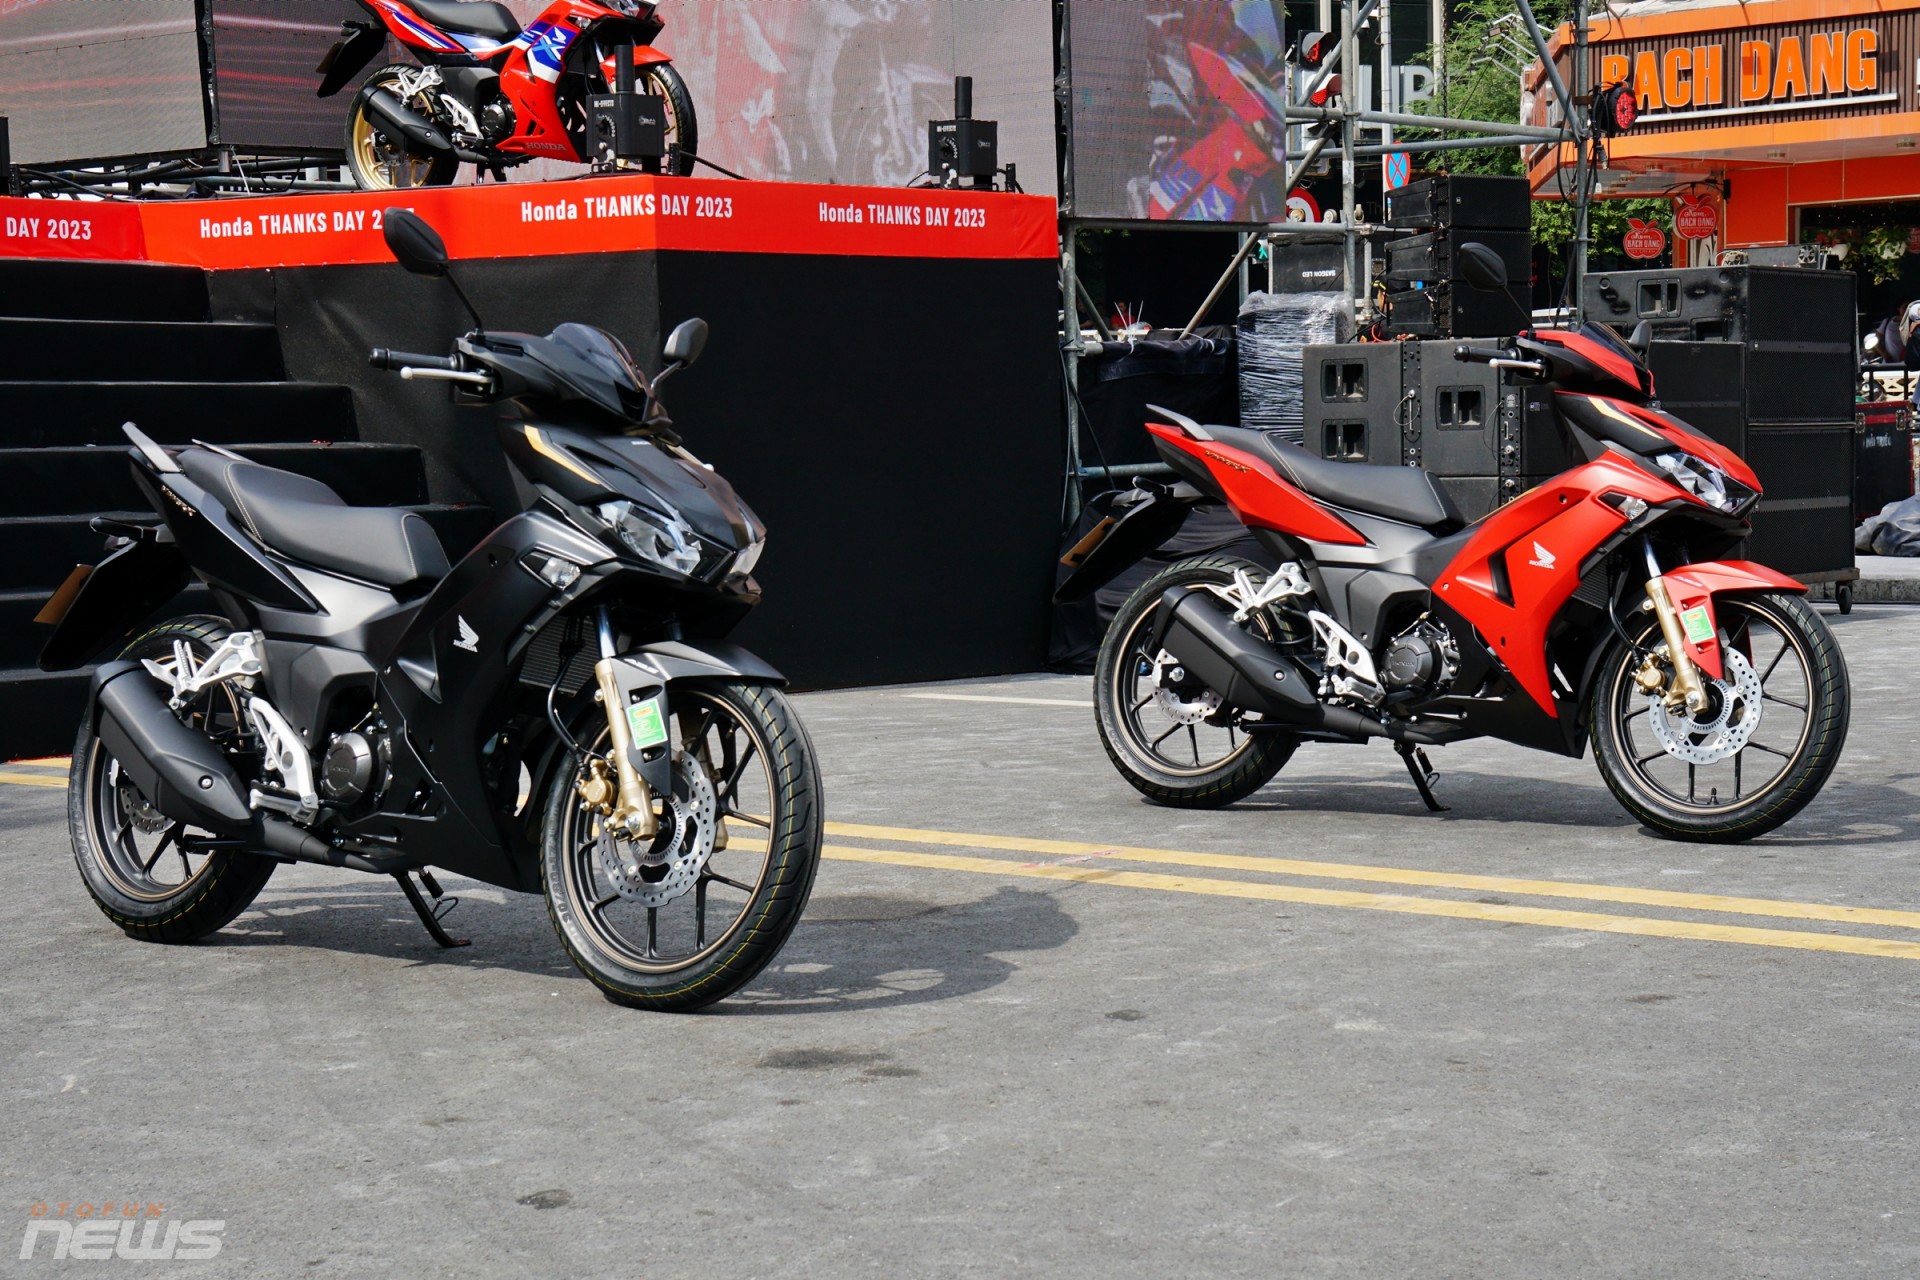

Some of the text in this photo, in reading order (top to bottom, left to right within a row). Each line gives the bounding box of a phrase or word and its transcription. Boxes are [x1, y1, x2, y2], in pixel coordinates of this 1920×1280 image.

[1739, 28, 1878, 101] DANG
[525, 141, 567, 151] HONDA
[521, 194, 733, 222] Honda THANKS DAY 2023
[819, 202, 986, 228] Honda THANKS DAY 2023
[6, 216, 92, 240] DAY 2023
[200, 216, 253, 238] Honda
[259, 212, 327, 235] THANKS
[333, 209, 366, 231] DAY
[1680, 217, 1714, 227] BACH DANG
[1627, 240, 1660, 248] BACH DANG
